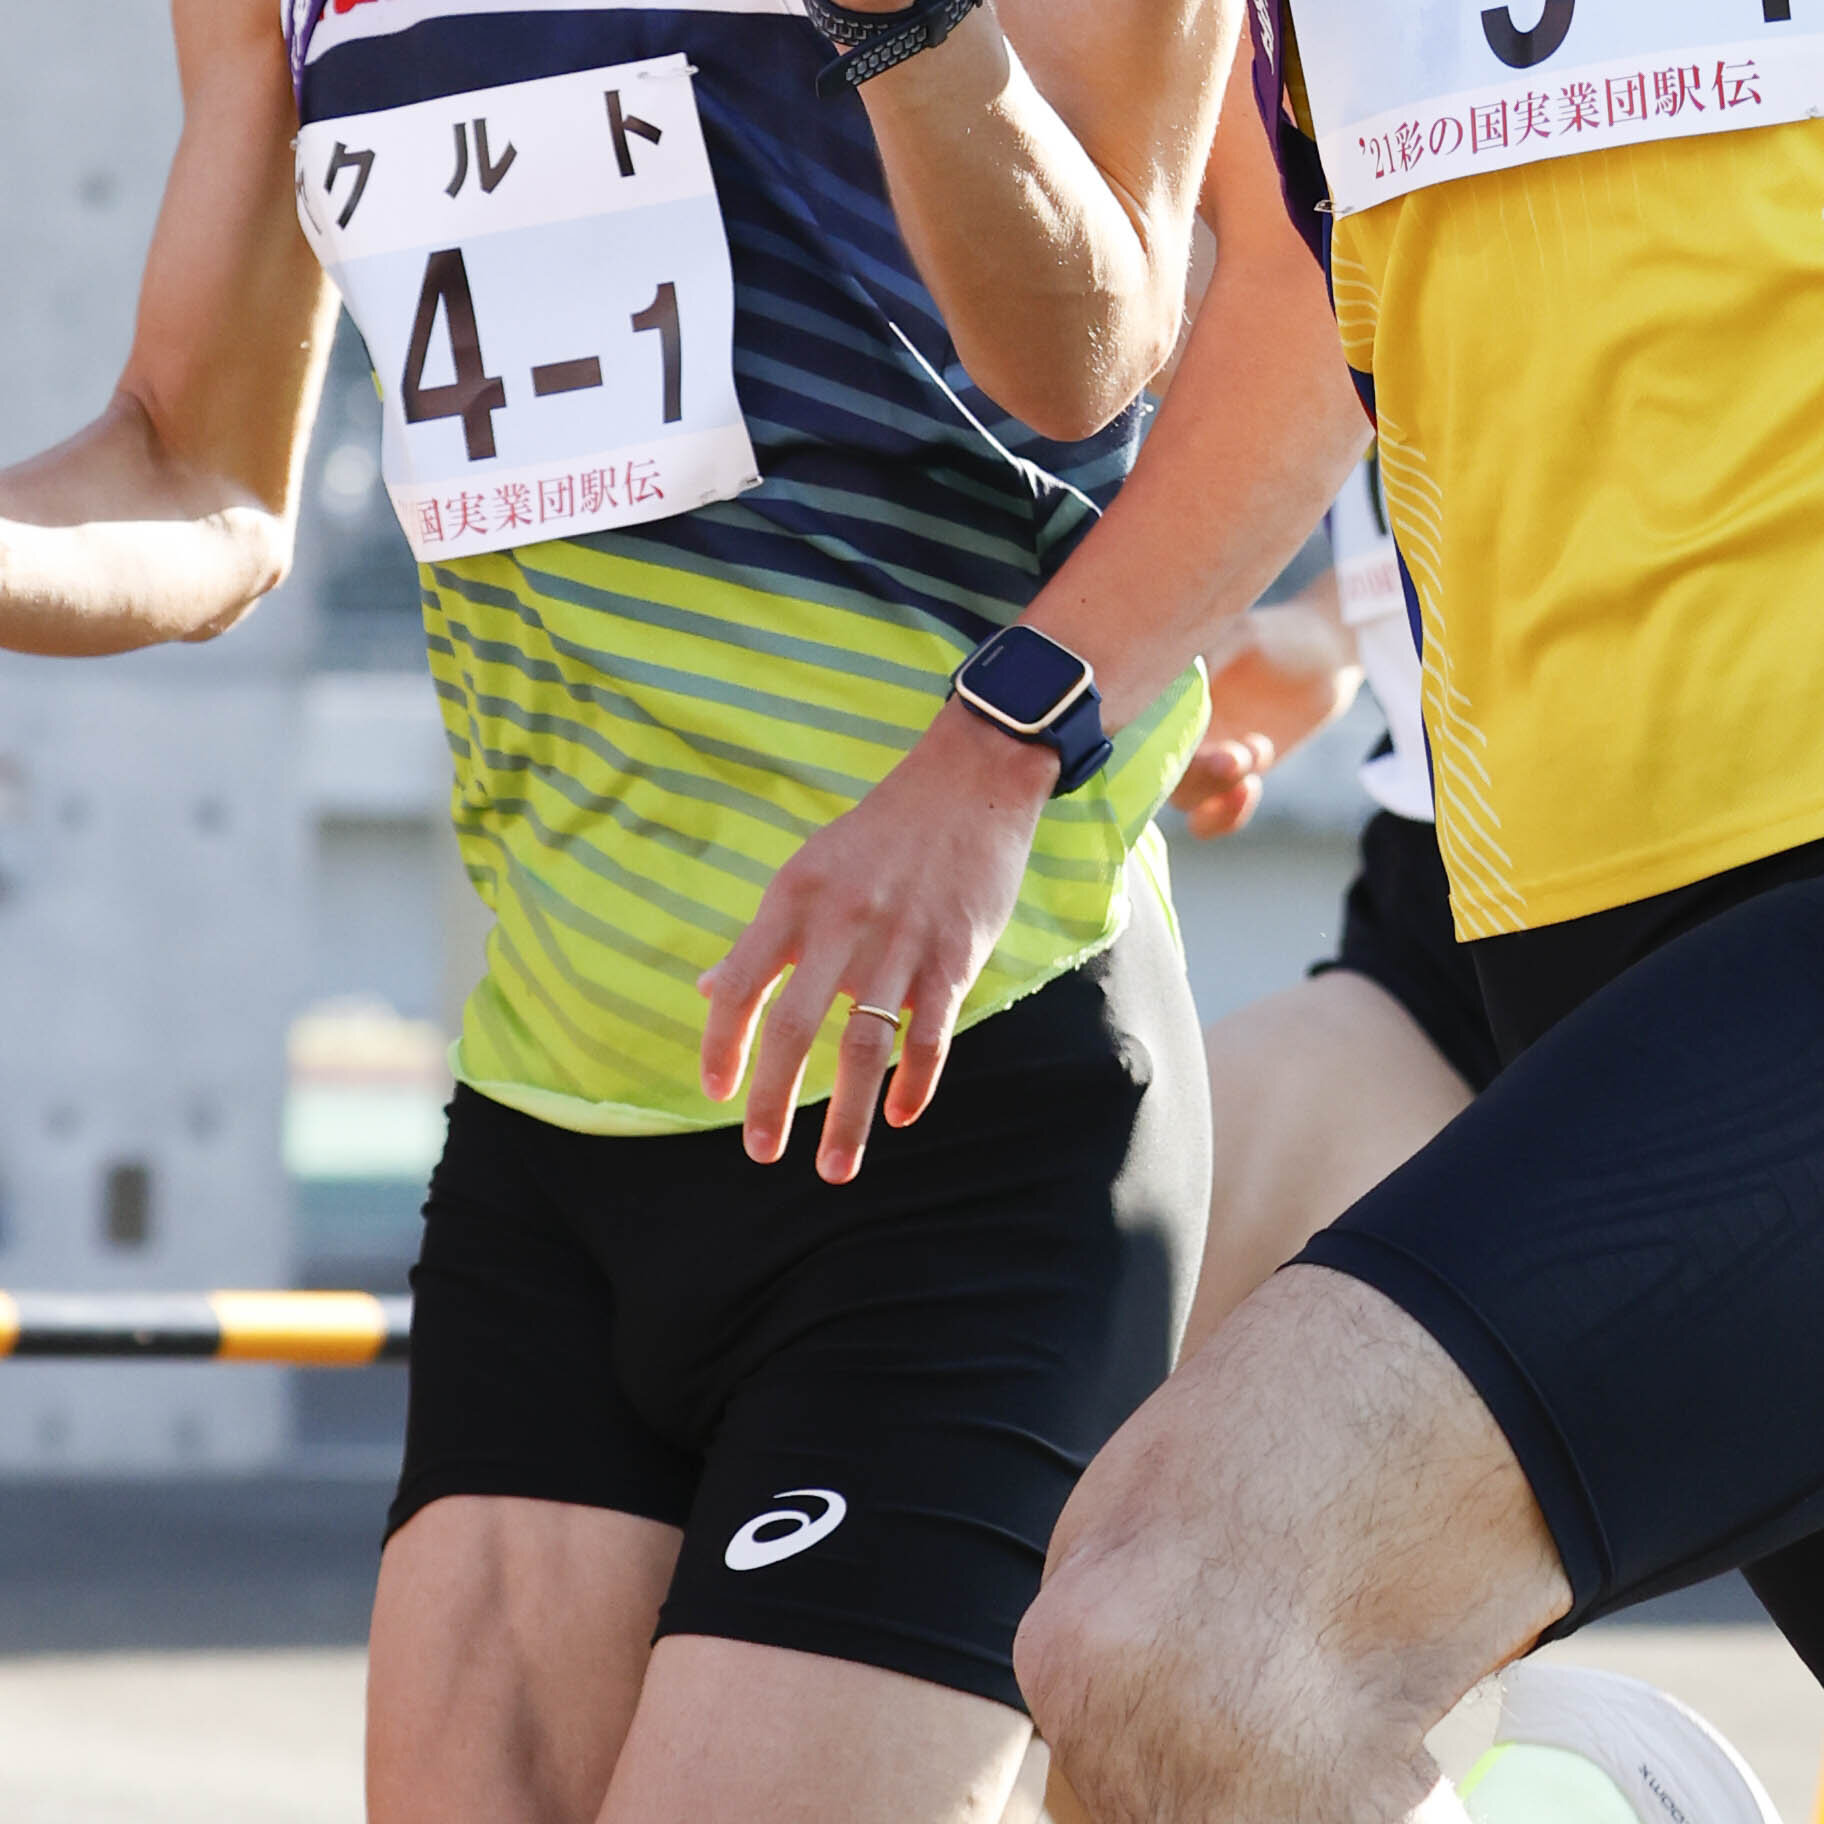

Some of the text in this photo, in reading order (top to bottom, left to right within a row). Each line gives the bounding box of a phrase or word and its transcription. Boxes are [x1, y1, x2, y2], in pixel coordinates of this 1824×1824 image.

[296, 90, 663, 235] クルト
[402, 247, 682, 462] 4-1
[399, 459, 665, 544] 国実業団駅伝
